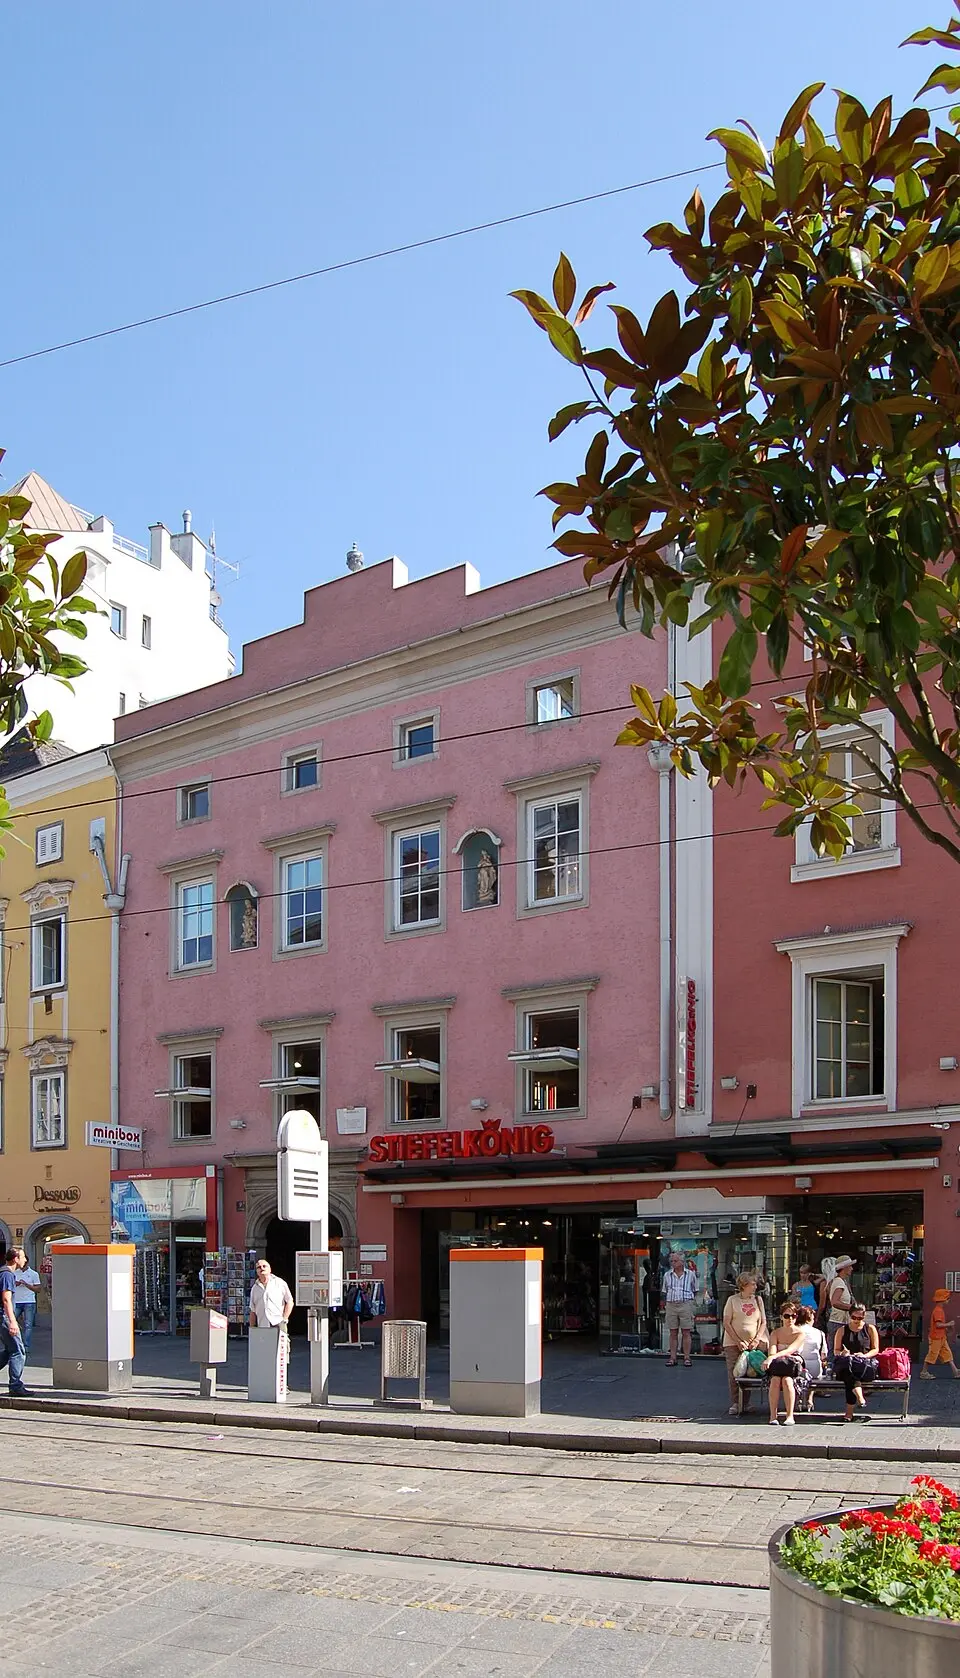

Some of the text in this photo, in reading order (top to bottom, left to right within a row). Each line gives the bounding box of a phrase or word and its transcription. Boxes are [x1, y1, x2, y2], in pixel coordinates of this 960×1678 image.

[93, 1126, 140, 1142] minibox
[369, 1119, 554, 1162] STIEFELKÖNIG
[33, 1185, 79, 1201] Dessous
[77, 1361, 83, 1371] 2
[117, 1361, 124, 1371] 2
